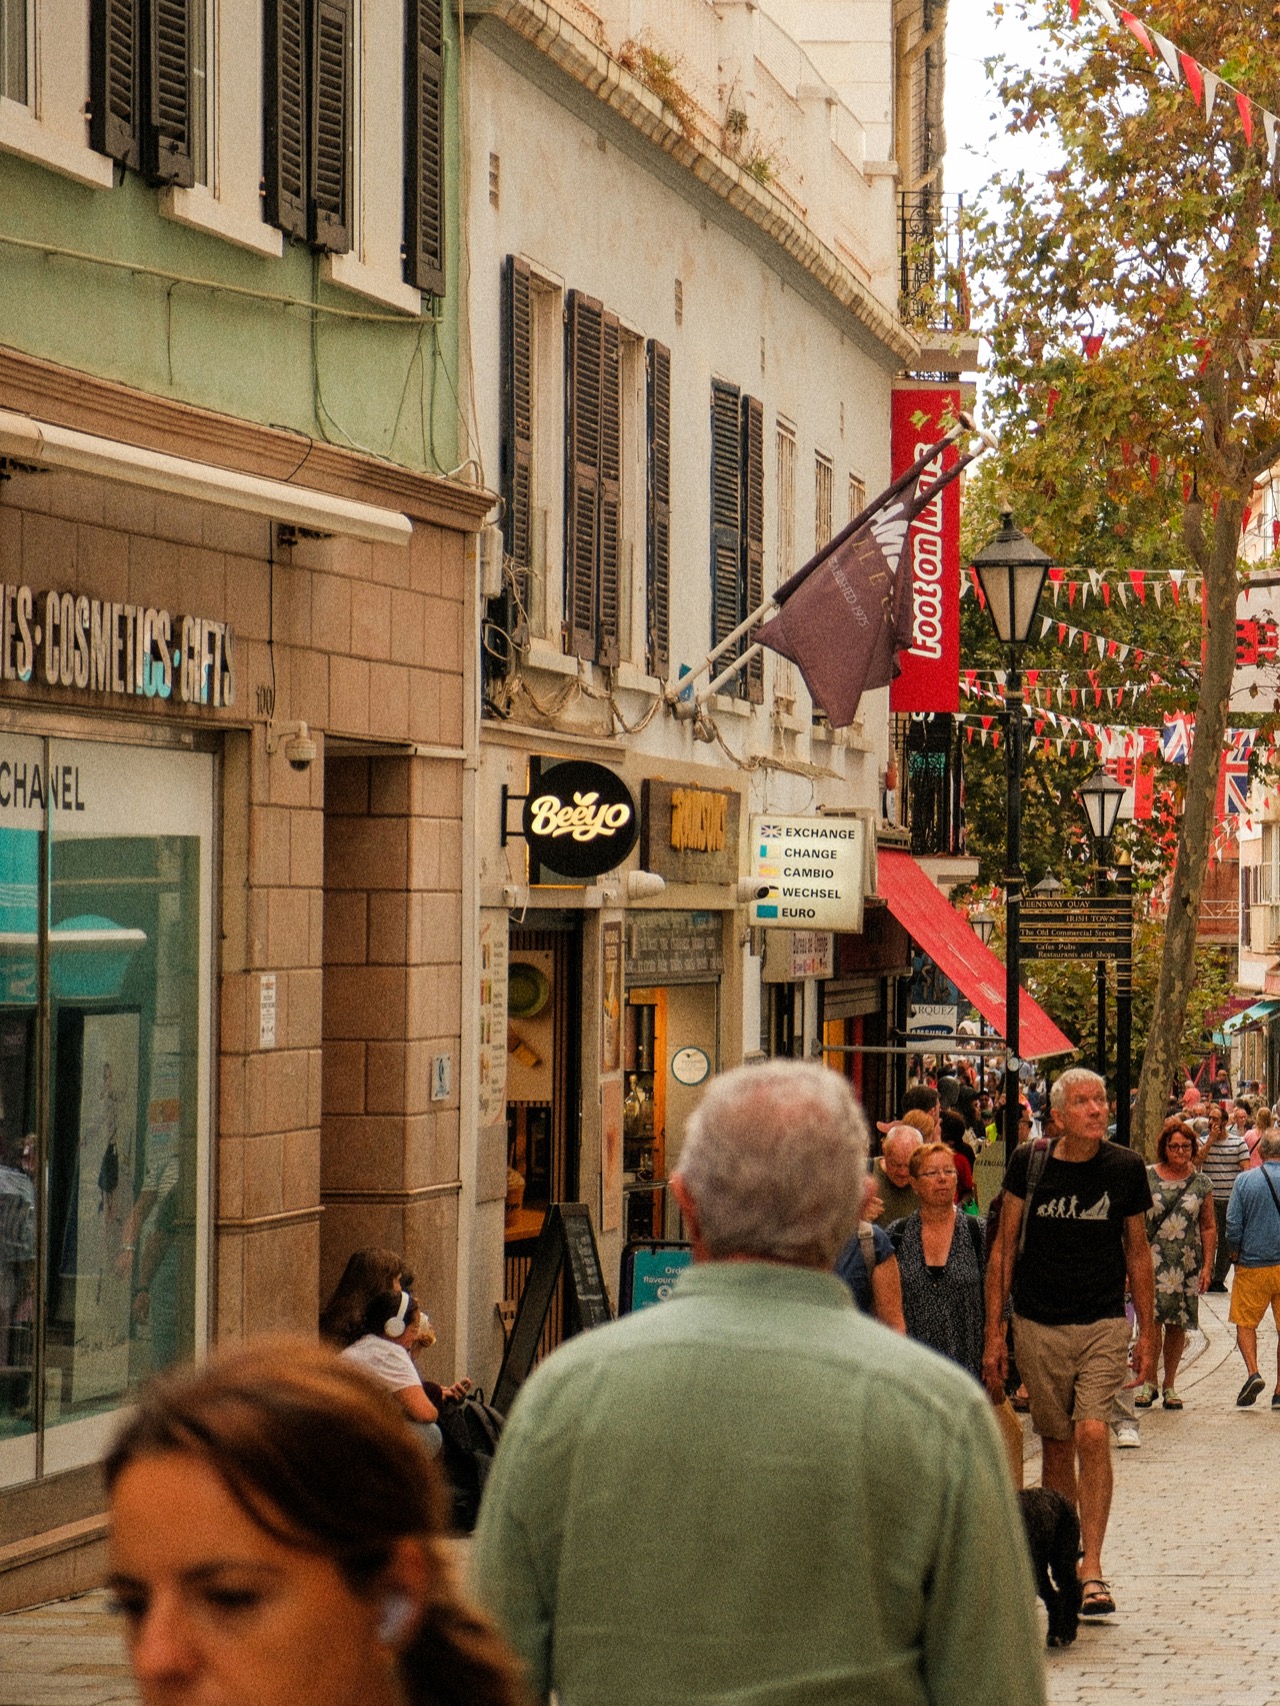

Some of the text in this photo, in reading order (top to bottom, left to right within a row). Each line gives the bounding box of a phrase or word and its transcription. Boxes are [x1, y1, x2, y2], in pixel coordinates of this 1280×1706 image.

[913, 534, 942, 582] on
[908, 582, 942, 660] Foot
[45, 590, 171, 698] COSMETICS
[179, 615, 235, 708] GIFTS
[0, 761, 85, 812] CHANEL
[530, 793, 630, 842] Beeyo
[785, 827, 855, 840] EXCHANGE
[784, 848, 837, 860] CHANGE
[783, 867, 834, 879] CAMBIO
[782, 887, 842, 899] WECHSEL
[1067, 900, 1091, 908] QUAY
[781, 907, 816, 919] EURO
[1096, 951, 1115, 959] Shops
